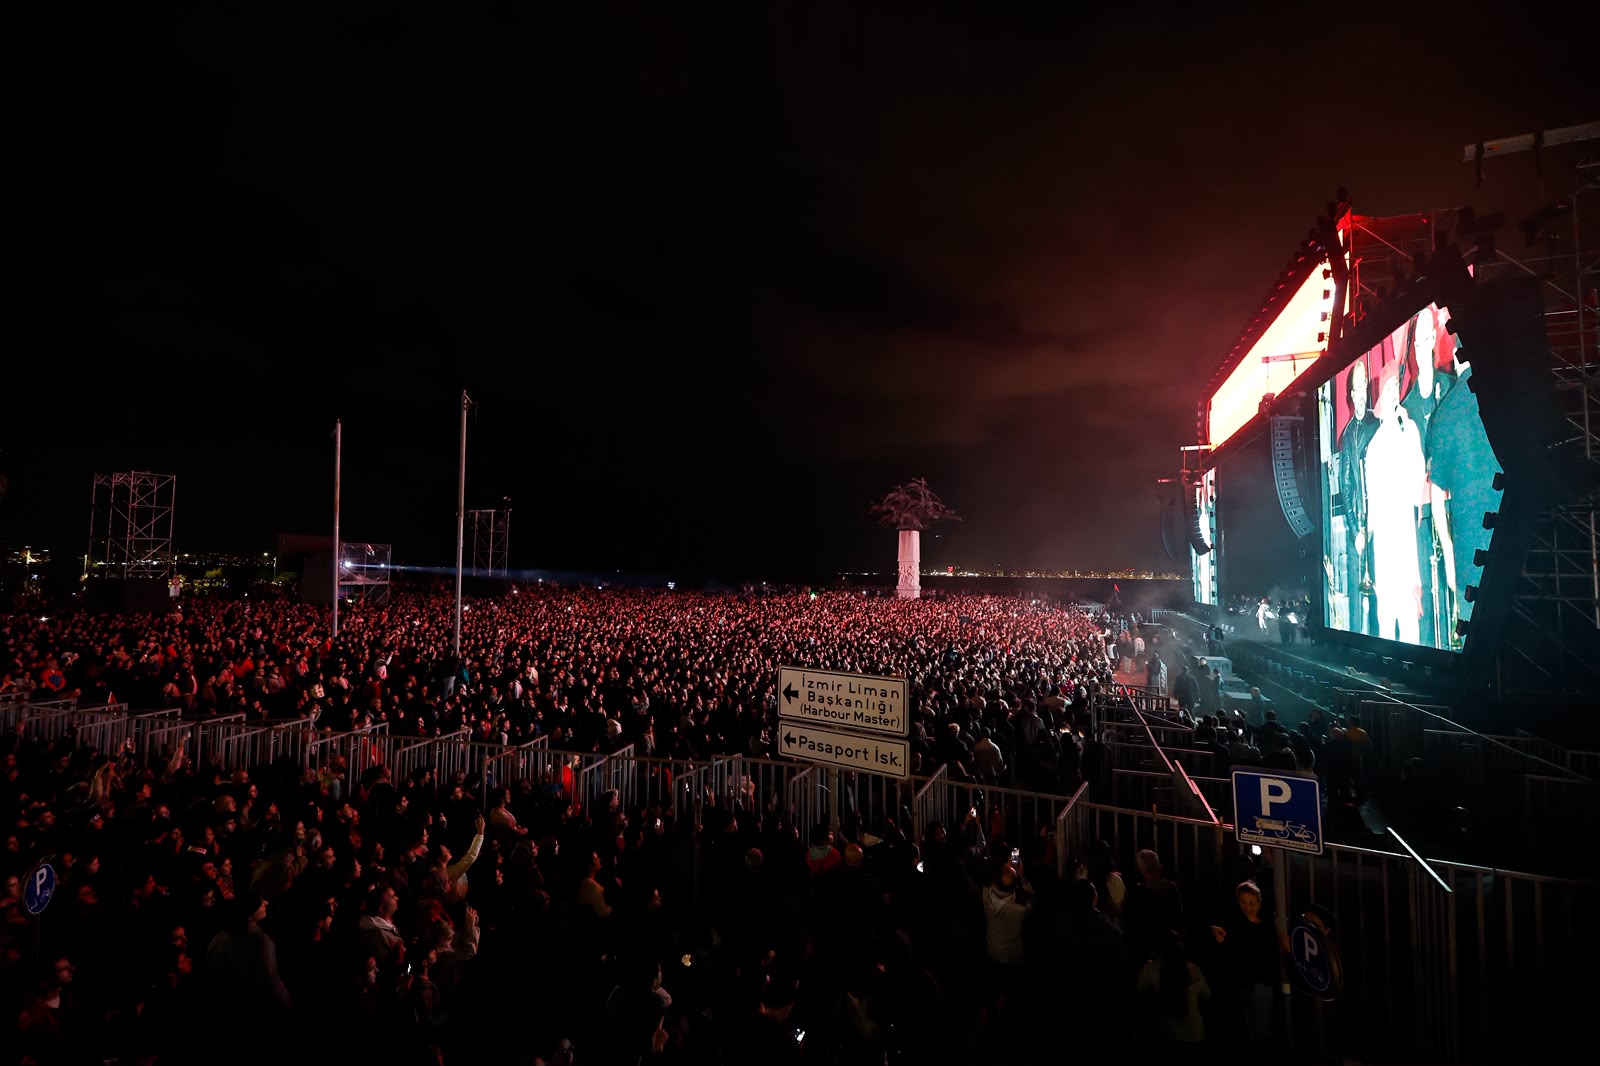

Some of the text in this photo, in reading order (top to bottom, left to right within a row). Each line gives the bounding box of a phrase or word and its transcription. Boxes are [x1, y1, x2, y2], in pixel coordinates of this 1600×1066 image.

[802, 673, 900, 699] İzmir Liman
[800, 704, 900, 728] (Harbour Master)
[807, 691, 892, 714] Başkanlığı
[799, 736, 902, 767] Pasaport İsk.
[1260, 777, 1292, 816] P
[36, 867, 47, 896] P
[1303, 930, 1319, 963] P
